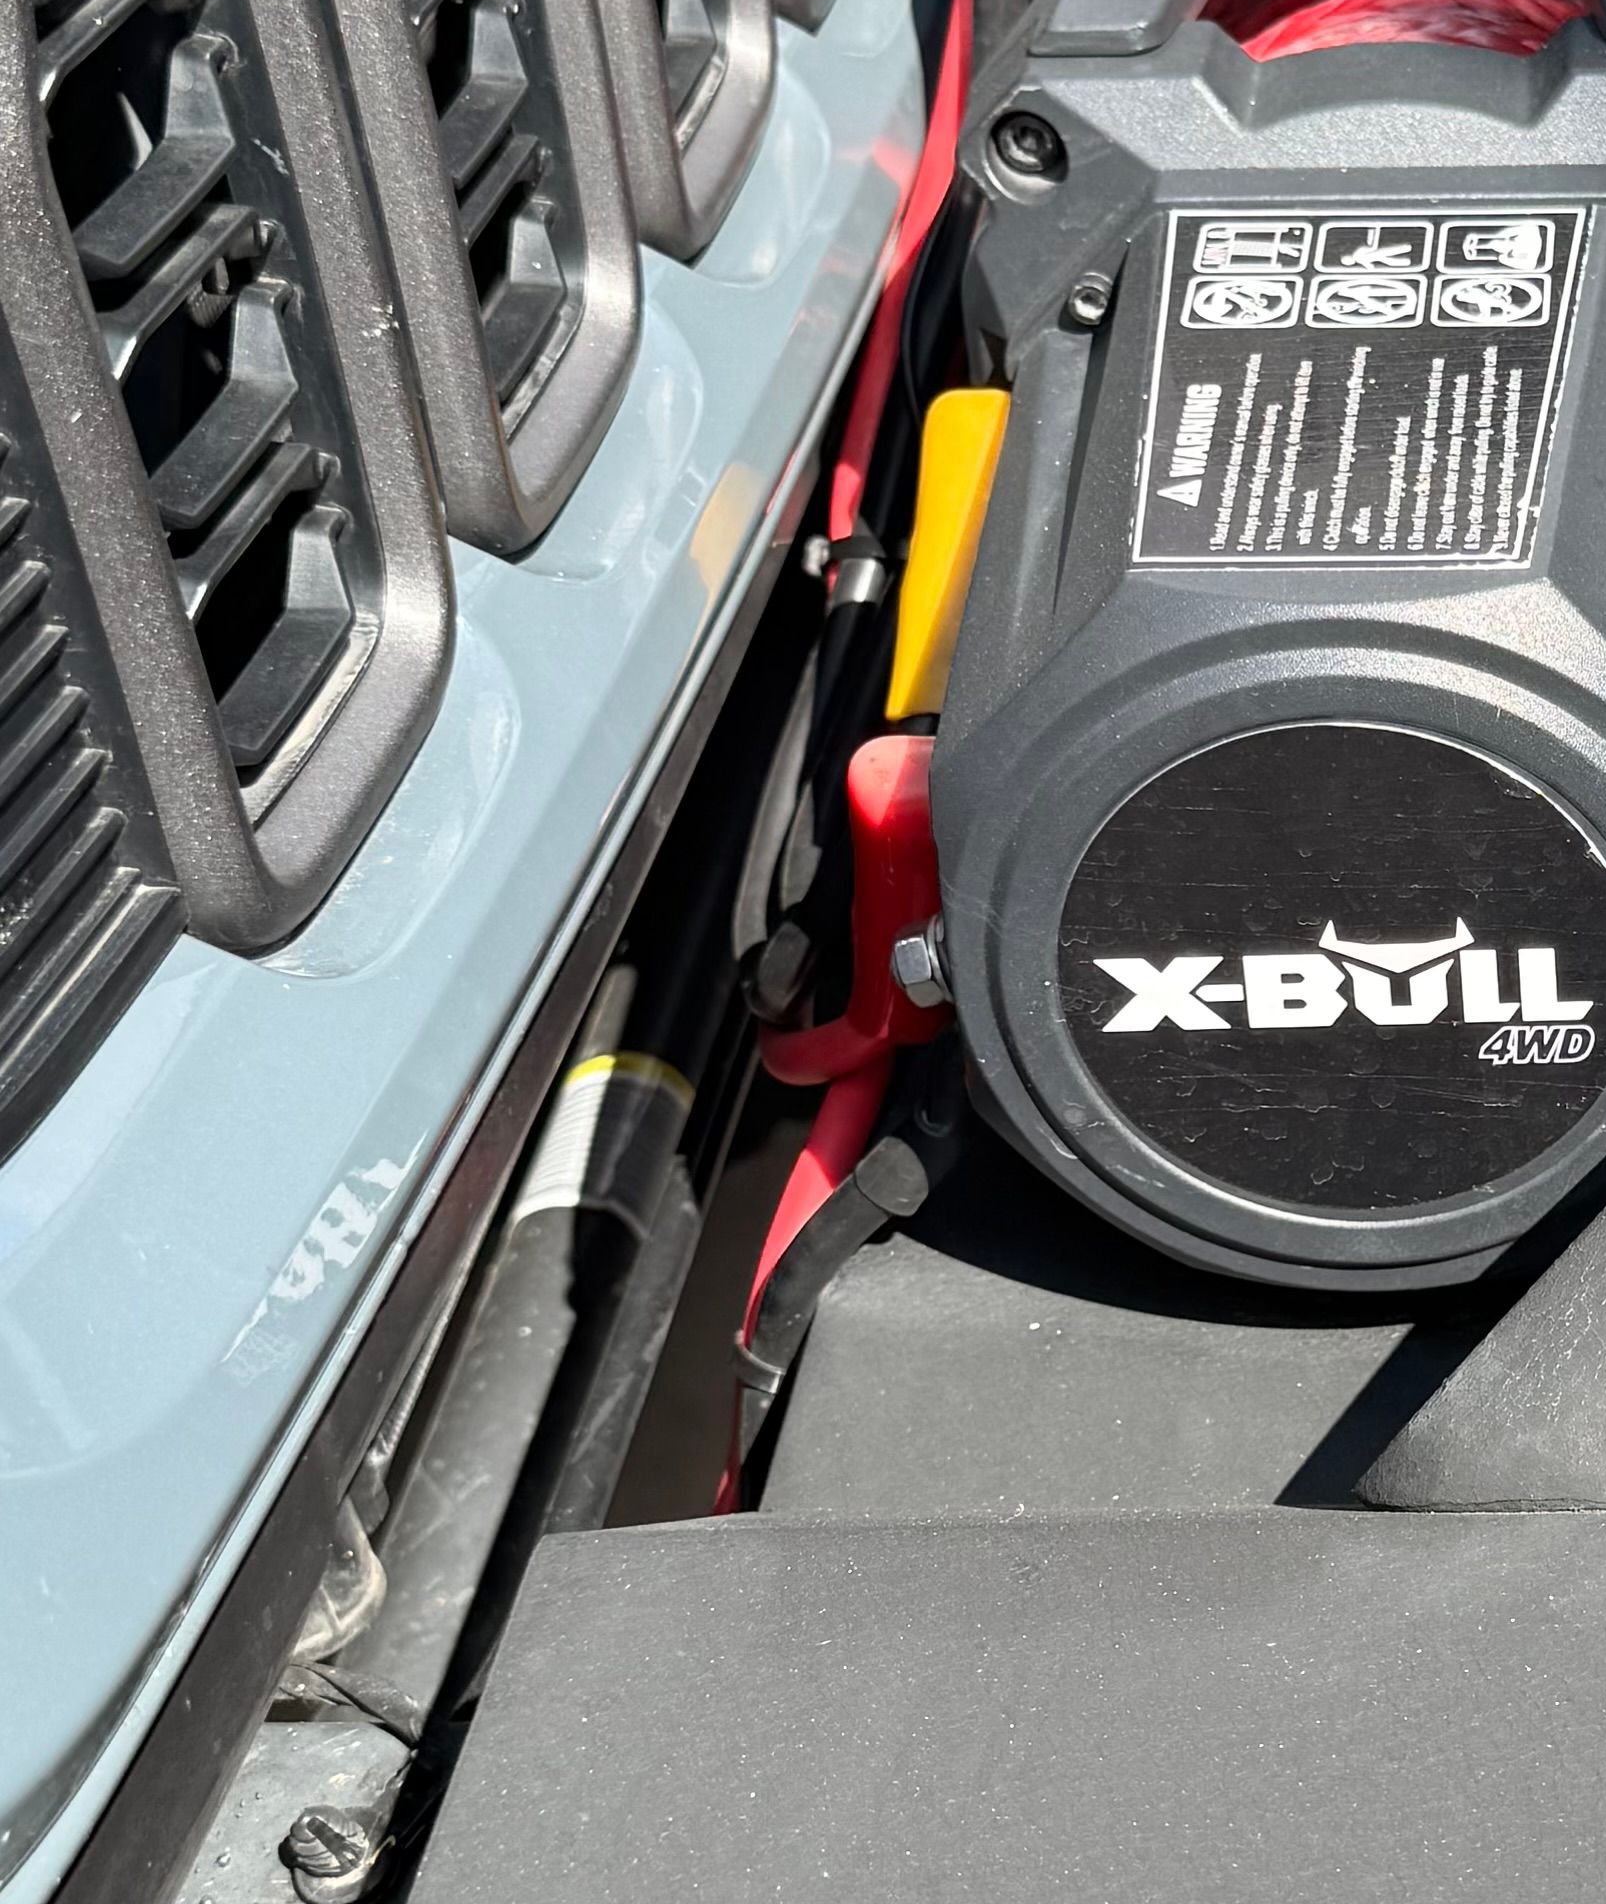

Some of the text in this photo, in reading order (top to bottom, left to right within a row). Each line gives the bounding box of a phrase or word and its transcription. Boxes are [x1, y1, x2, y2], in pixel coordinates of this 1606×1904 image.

[1169, 384, 1222, 477] WARNING
[1093, 943, 1594, 1033] X-BULL
[1477, 1024, 1597, 1066] 4WD
